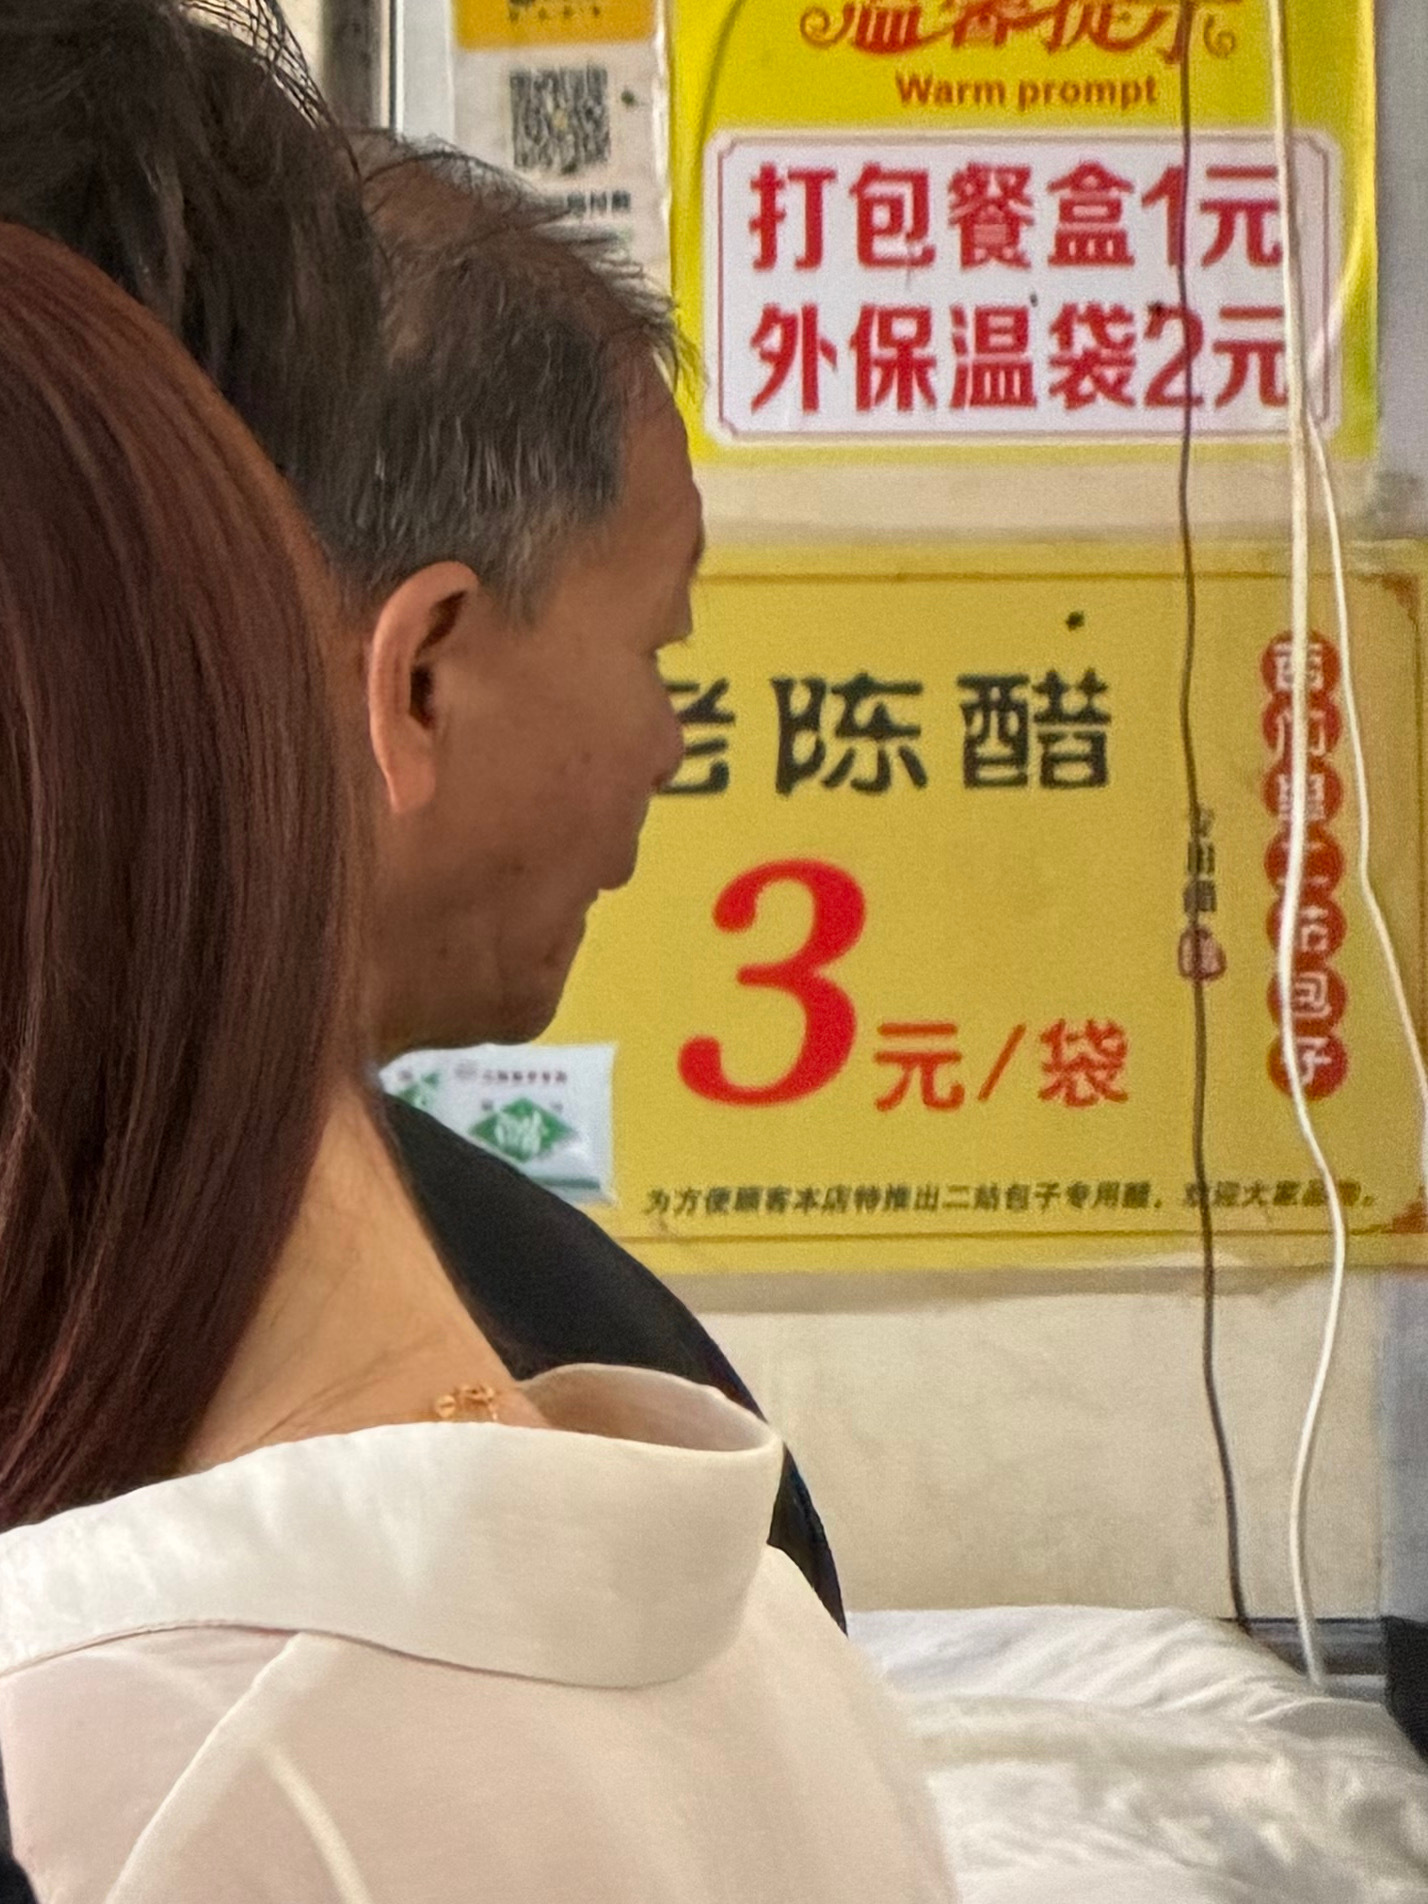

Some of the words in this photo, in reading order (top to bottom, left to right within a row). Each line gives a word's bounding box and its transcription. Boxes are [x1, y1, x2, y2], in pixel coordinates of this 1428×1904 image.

[896, 70, 1007, 109] Warm
[1017, 72, 1158, 114] prompt
[748, 159, 1284, 274] 打包餐盒1元
[749, 300, 1289, 416] 外保温袋2元
[677, 858, 1130, 1110] 3元/袋
